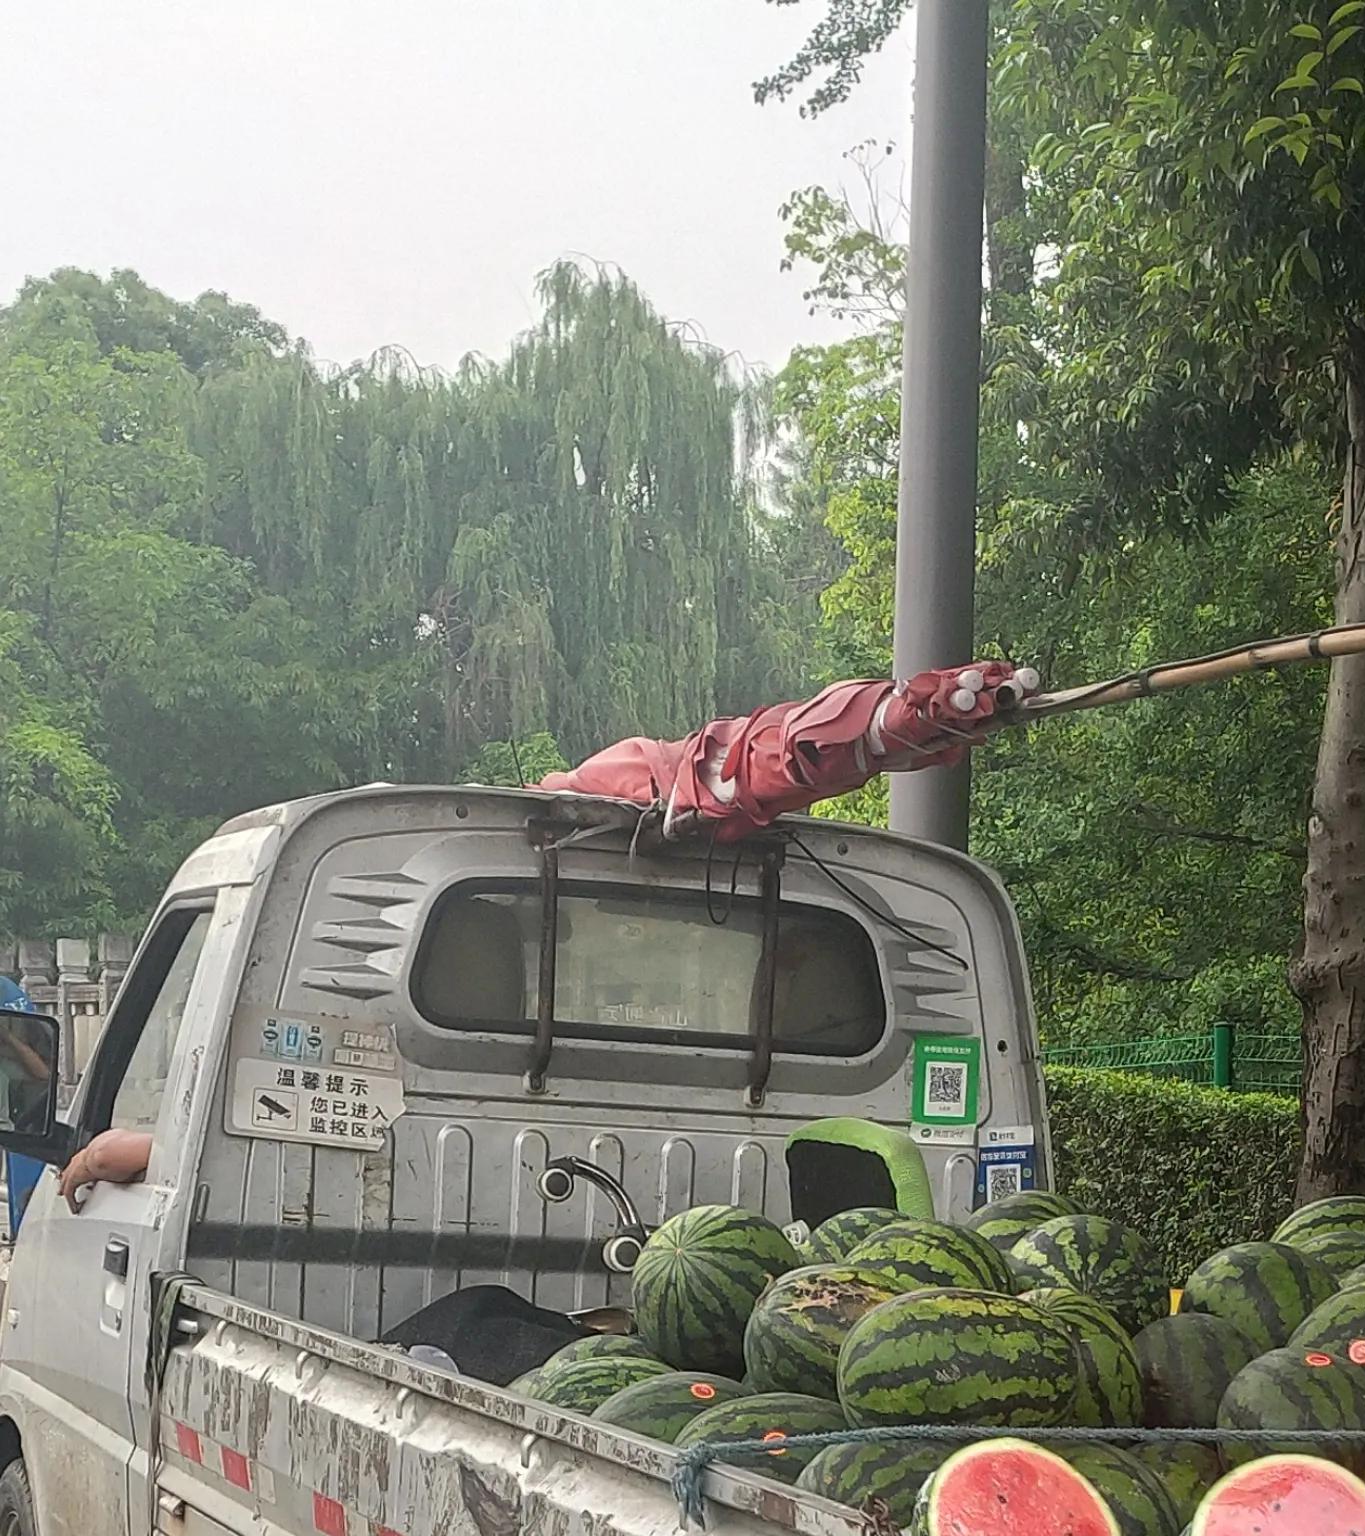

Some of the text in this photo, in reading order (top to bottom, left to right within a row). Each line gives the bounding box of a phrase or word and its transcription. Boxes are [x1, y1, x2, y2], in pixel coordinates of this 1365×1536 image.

[276, 1067, 369, 1097] 温馨提示
[309, 1096, 389, 1122] 您已进入
